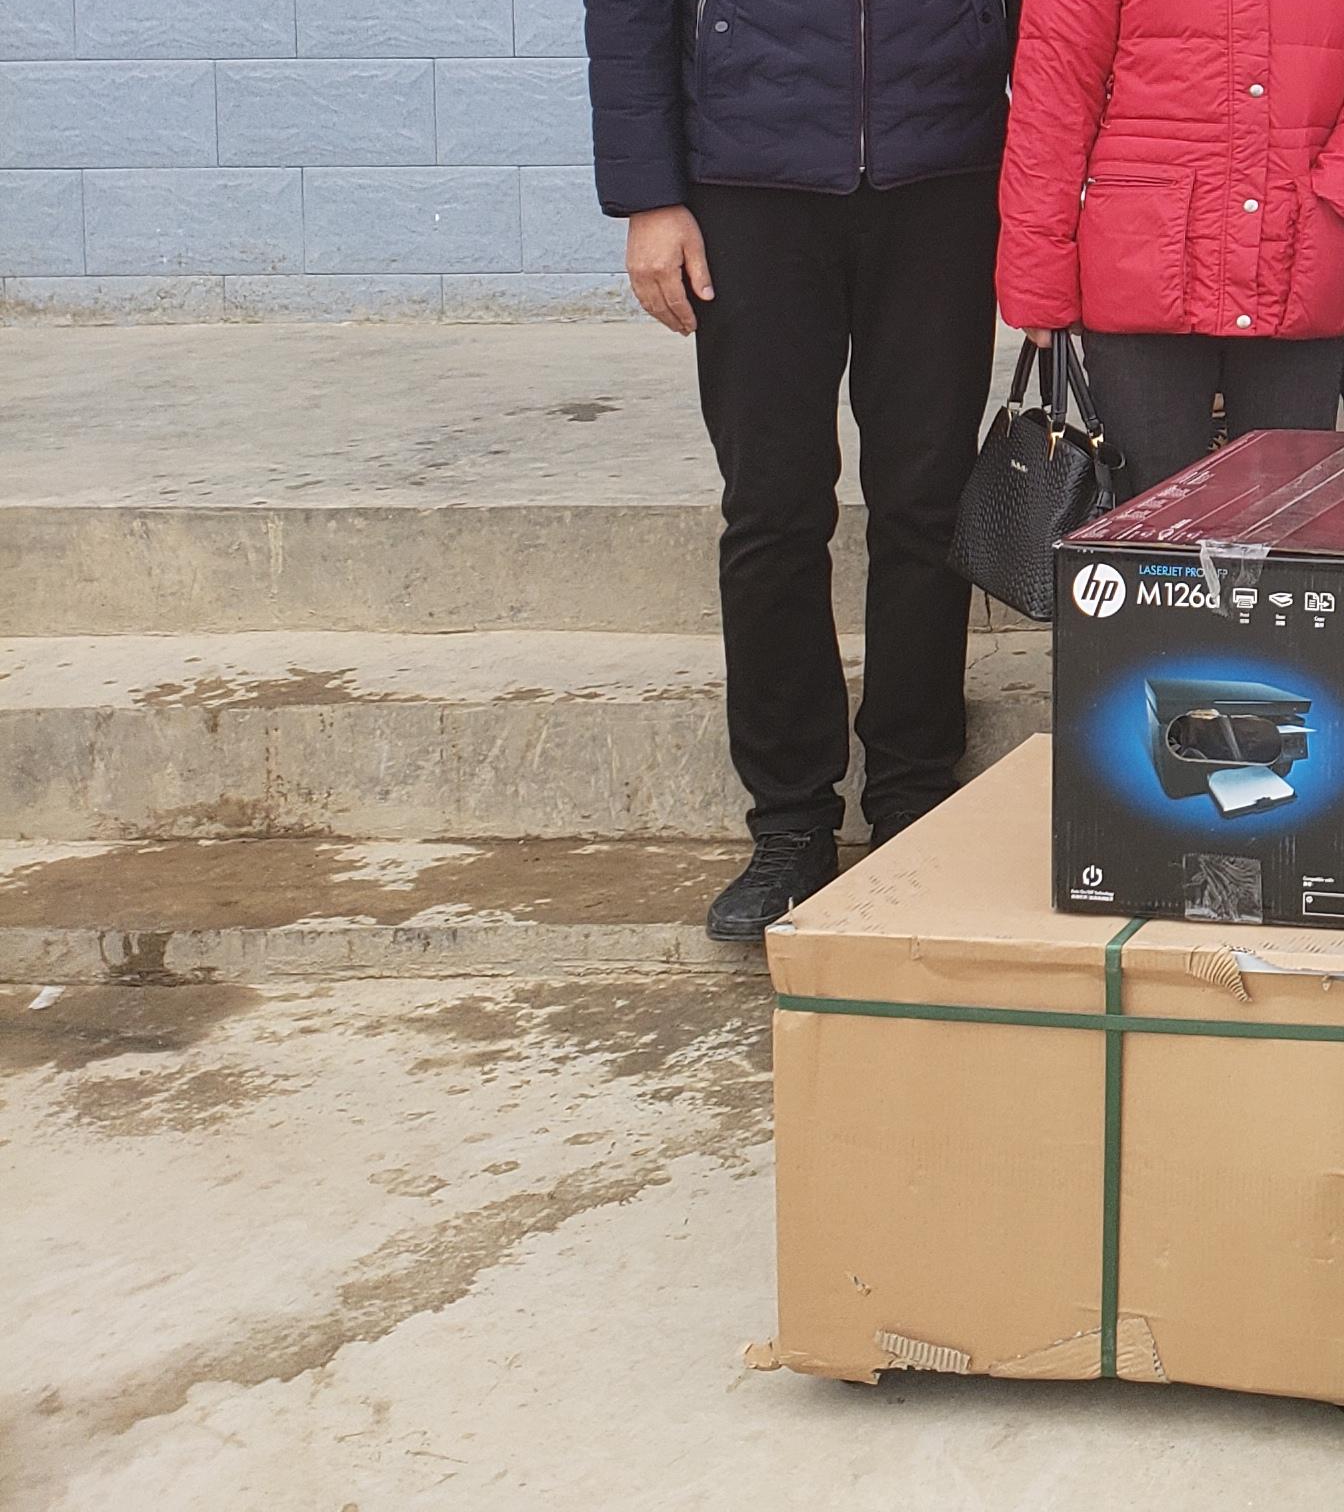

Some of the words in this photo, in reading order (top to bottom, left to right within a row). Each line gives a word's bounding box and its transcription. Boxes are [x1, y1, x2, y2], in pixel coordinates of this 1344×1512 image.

[1139, 564, 1183, 577] LASERJET
[1075, 564, 1124, 618] hp
[1137, 582, 1221, 609] M126a
